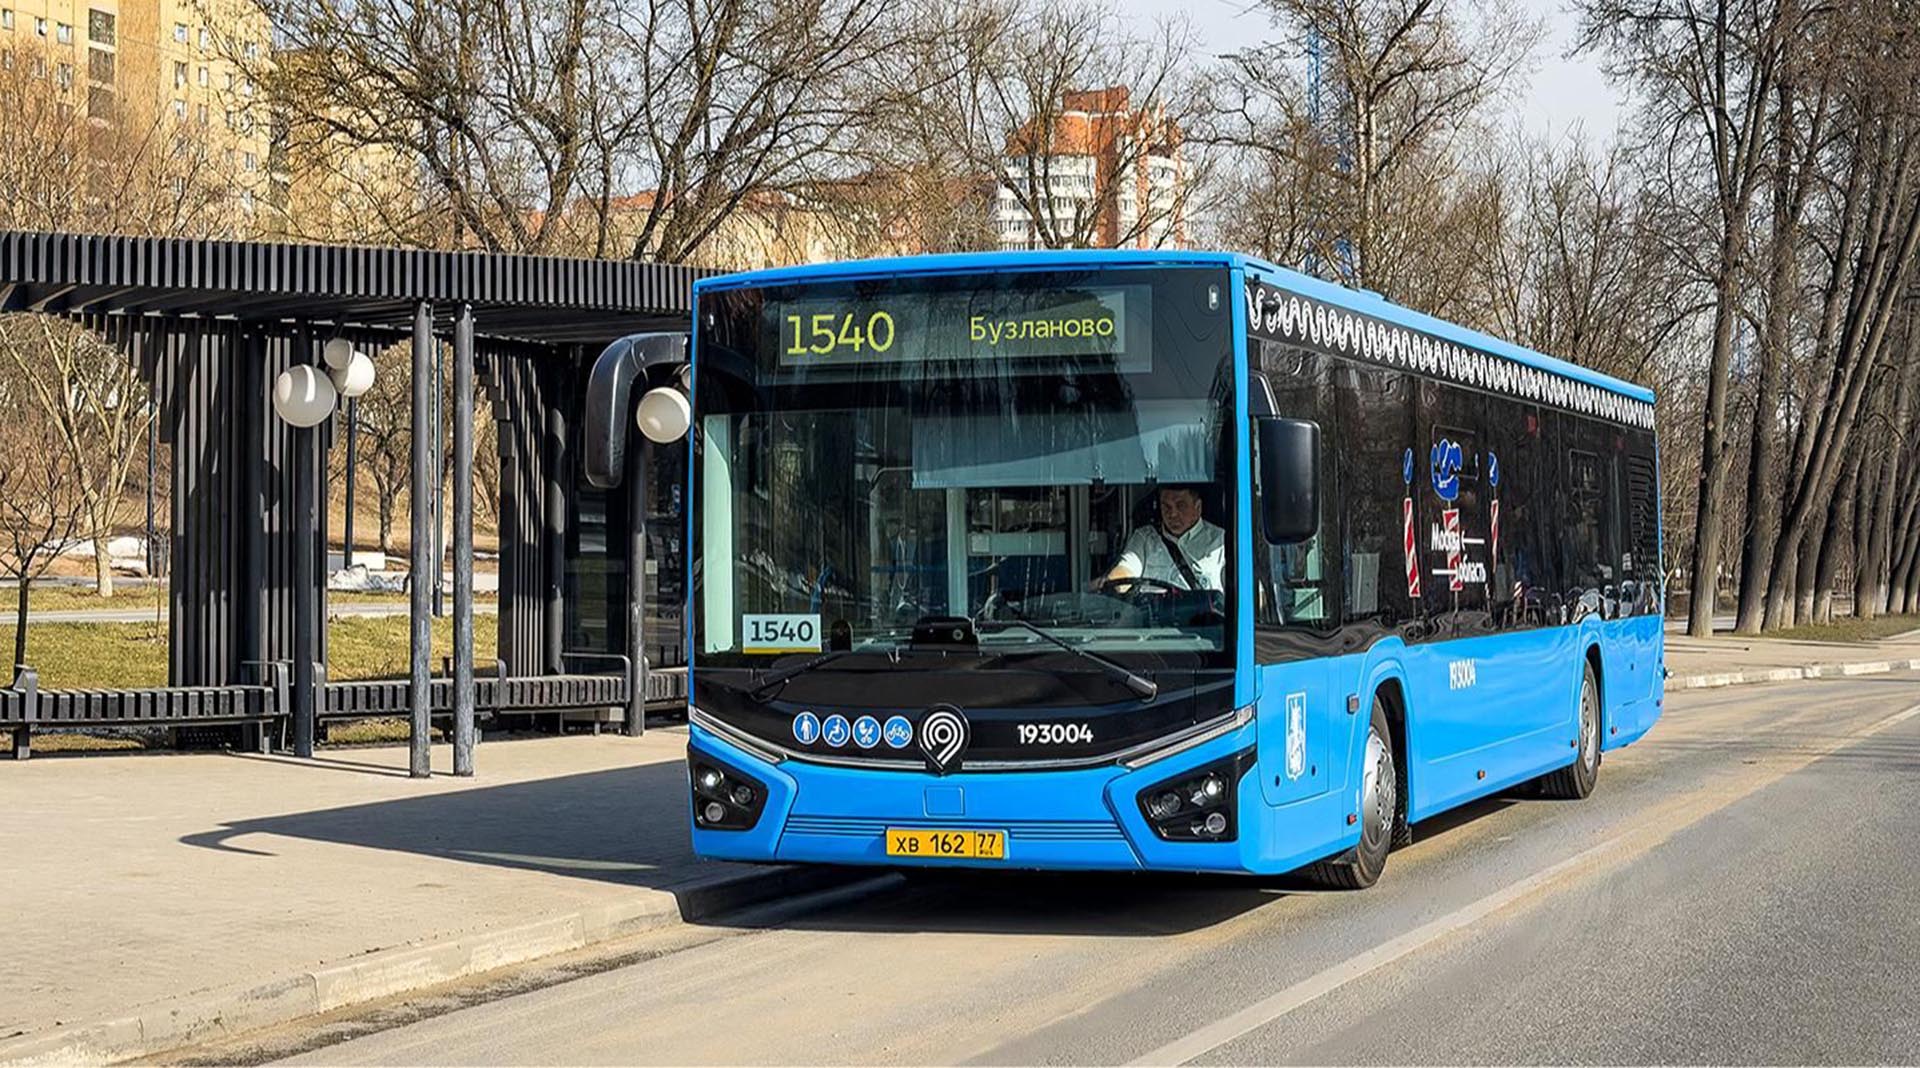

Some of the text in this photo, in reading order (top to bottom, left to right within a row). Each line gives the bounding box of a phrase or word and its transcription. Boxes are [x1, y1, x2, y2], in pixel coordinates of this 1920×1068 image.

[787, 311, 1114, 355] 1540 Бузланово
[750, 620, 814, 642] 1540
[1449, 658, 1476, 689] 193004
[1017, 723, 1094, 744] 193004
[896, 837, 920, 853] ХВ
[929, 833, 965, 854] 162
[977, 833, 997, 849] 77
